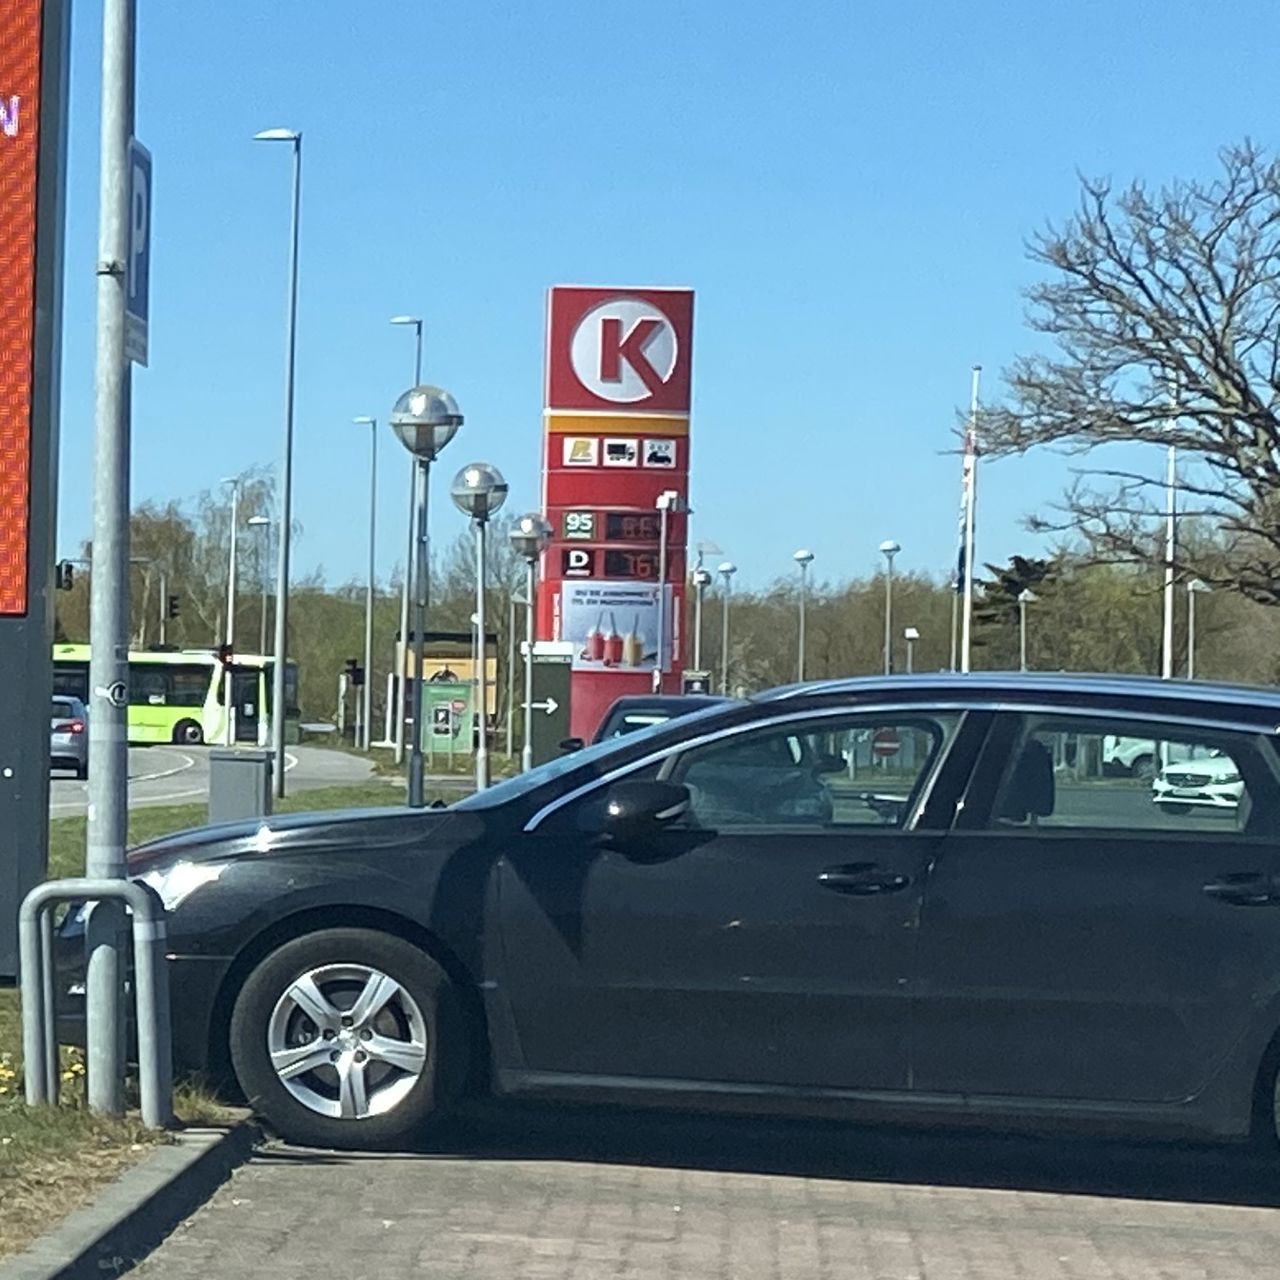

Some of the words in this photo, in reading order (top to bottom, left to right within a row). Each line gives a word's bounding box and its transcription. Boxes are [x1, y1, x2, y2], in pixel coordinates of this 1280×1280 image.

[130, 162, 147, 298] P
[600, 317, 667, 393] K
[566, 512, 593, 531] 95
[569, 550, 590, 568] D
